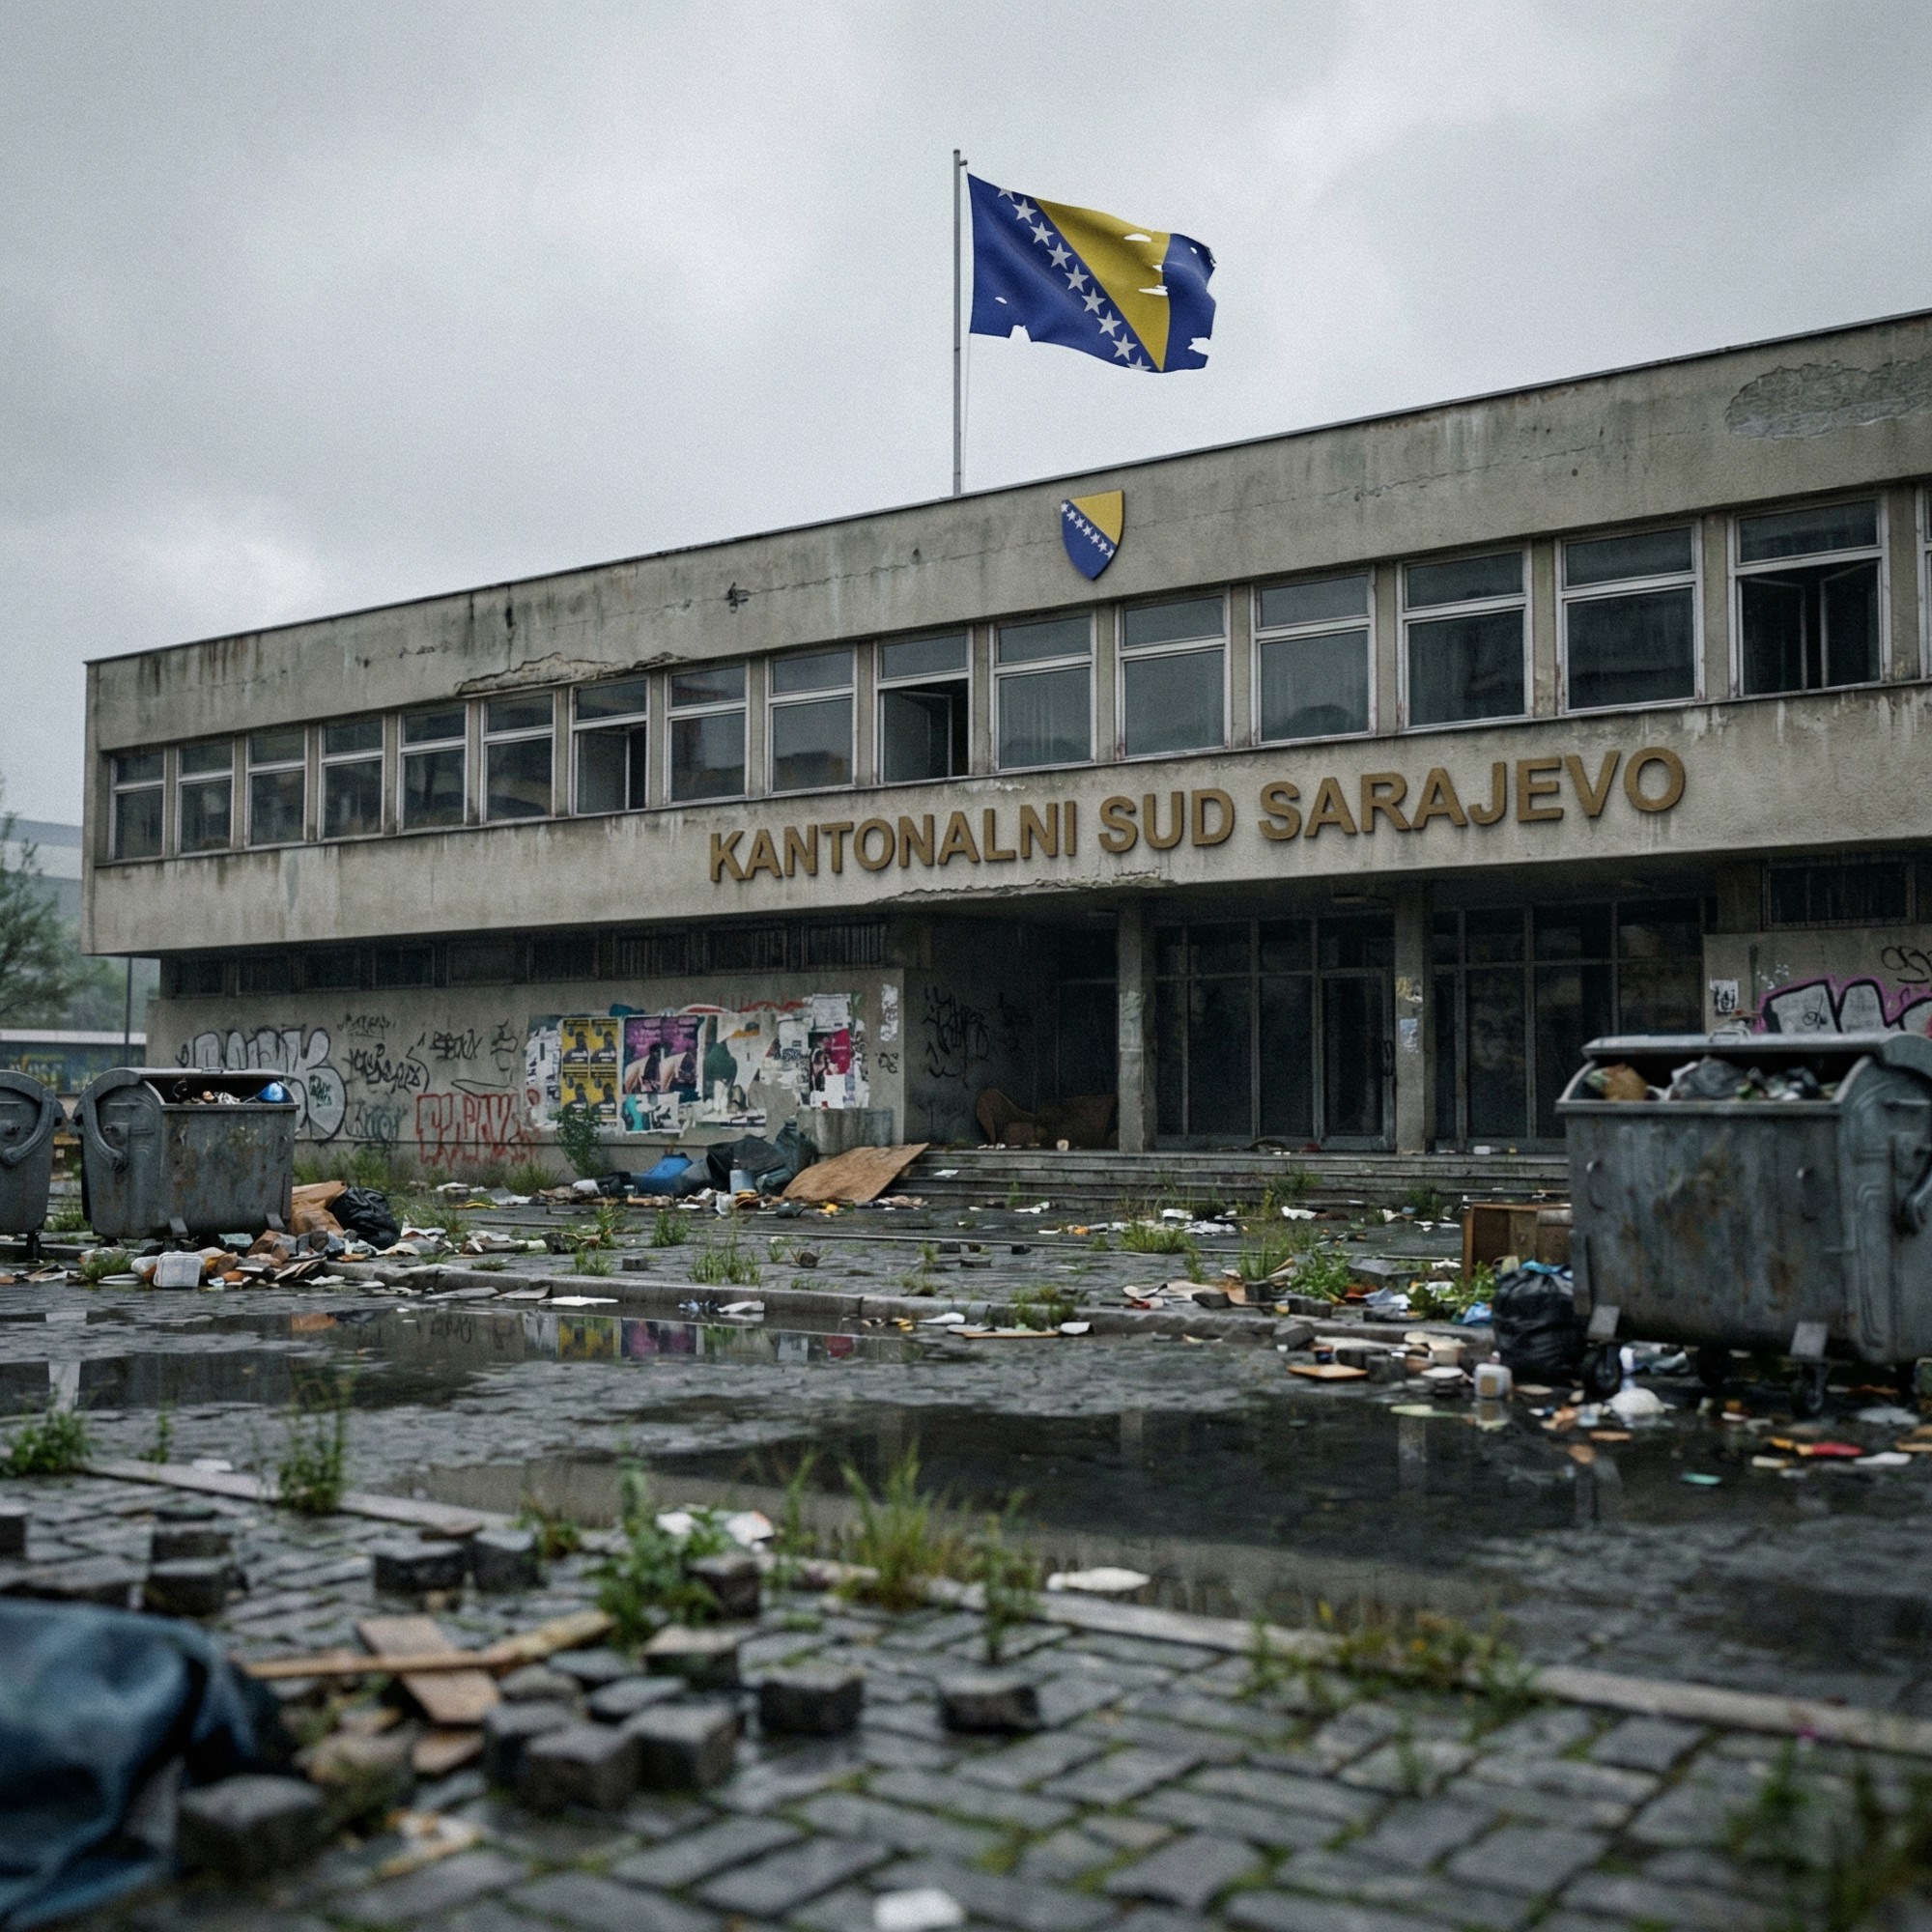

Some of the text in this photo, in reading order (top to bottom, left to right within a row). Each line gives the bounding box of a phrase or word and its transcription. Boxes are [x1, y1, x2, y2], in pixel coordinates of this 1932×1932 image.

[710, 747, 1685, 881] KANTONALNI SUD SARAJEVO
